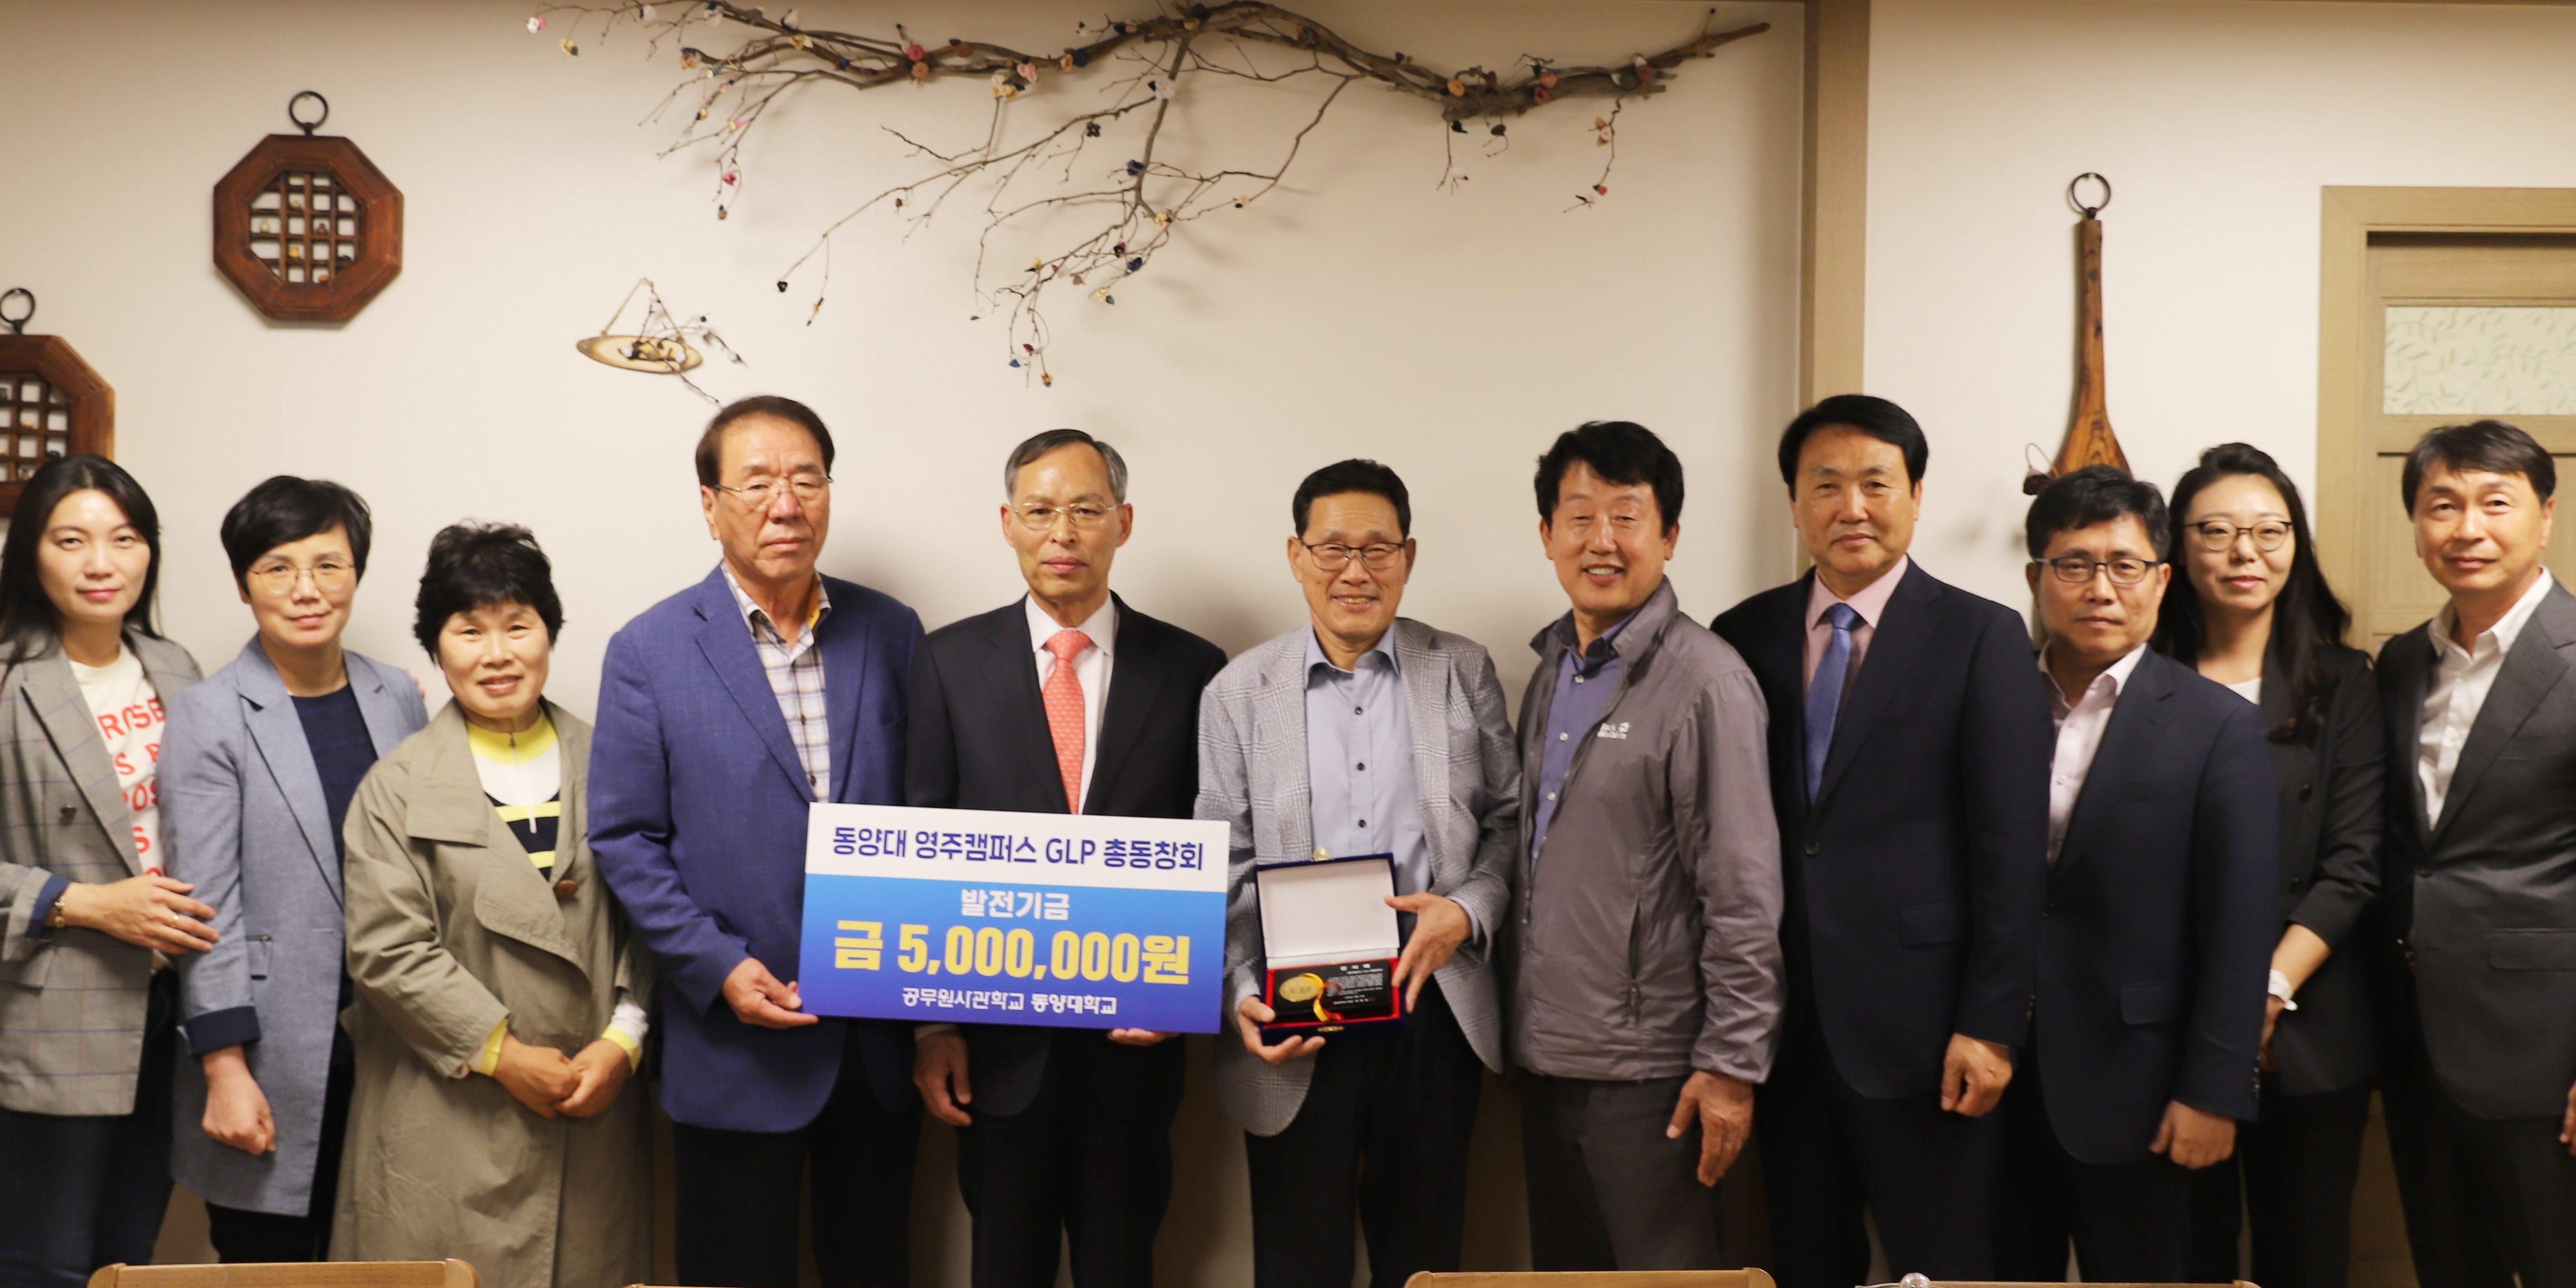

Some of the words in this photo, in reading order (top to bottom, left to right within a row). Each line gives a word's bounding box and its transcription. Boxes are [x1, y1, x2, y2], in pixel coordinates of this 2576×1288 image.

[832, 827, 907, 857] 동양대
[915, 831, 1037, 863] 영주캠퍼스
[1046, 838, 1096, 864] GLP
[1103, 839, 1203, 871] 총동창회
[961, 889, 1070, 921] 발전기금
[834, 920, 883, 971] 금
[897, 924, 1190, 985] 5,000,000원
[902, 987, 1025, 1010] 공무원사관학교
[1031, 993, 1117, 1015] 동양대학교
